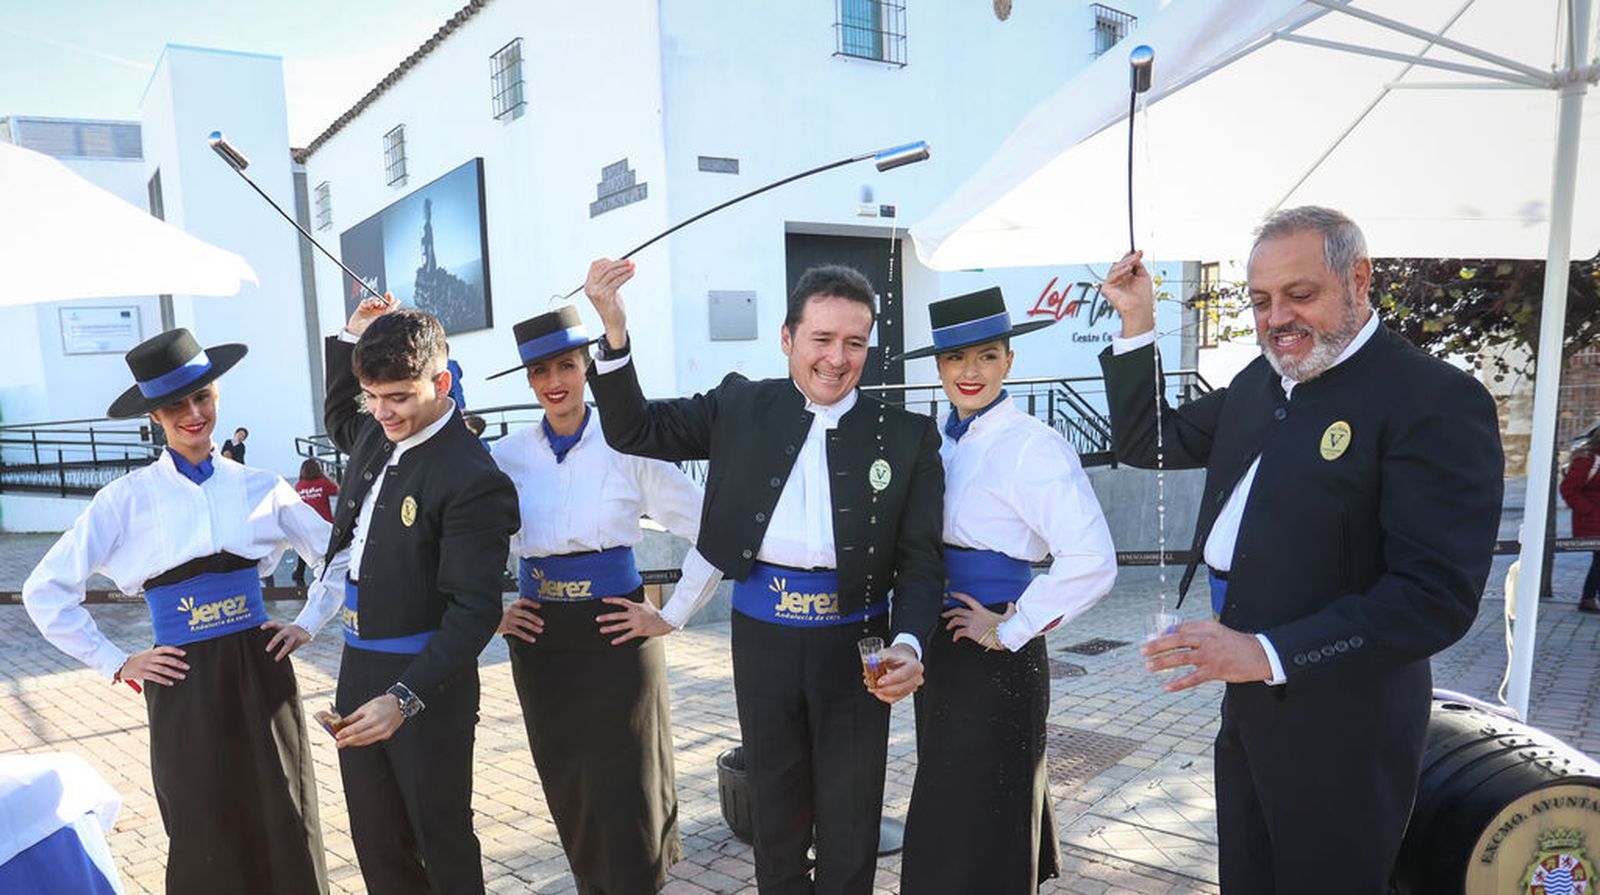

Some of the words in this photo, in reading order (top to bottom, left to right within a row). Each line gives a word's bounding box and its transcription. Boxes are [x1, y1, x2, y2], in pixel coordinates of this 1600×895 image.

[1027, 276, 1077, 321] Lola
[1074, 282, 1121, 327] Flor
[1072, 331, 1100, 343] Centro
[1102, 331, 1112, 343] Cu
[1330, 432, 1346, 449] V
[875, 467, 887, 480] V
[1481, 812, 1528, 863] EXCMO.
[1531, 796, 1600, 816] AYUNTA
